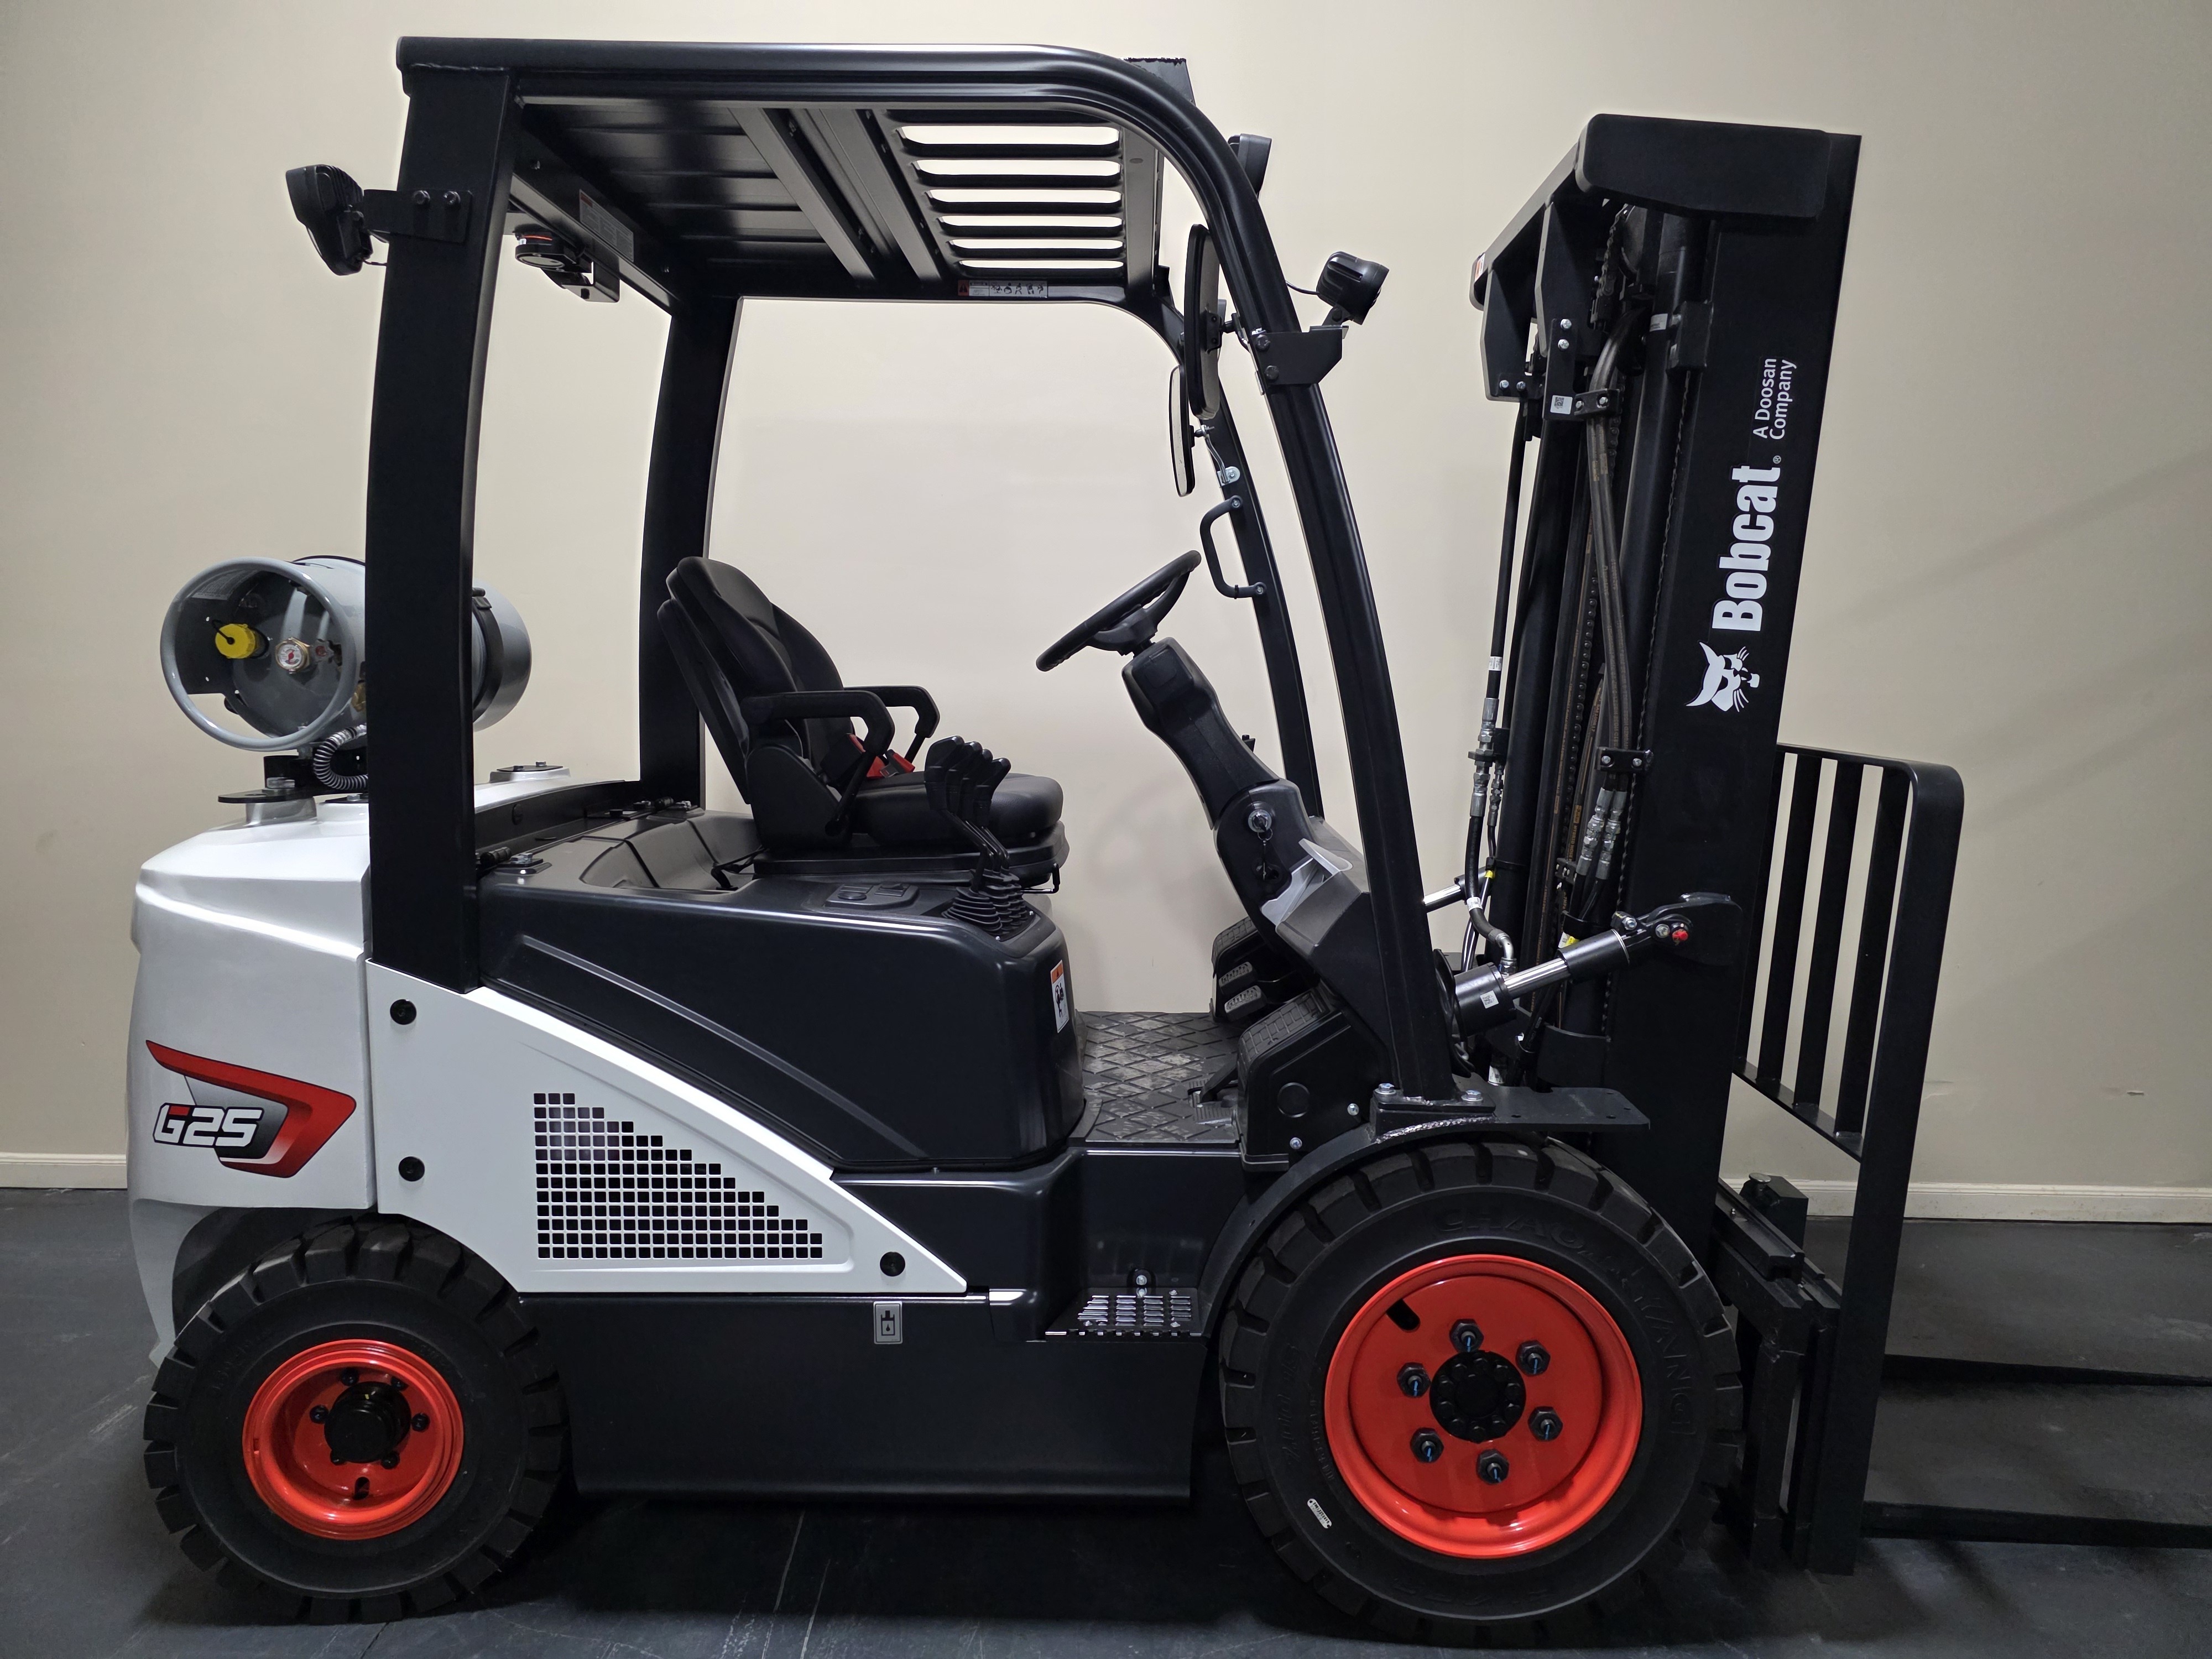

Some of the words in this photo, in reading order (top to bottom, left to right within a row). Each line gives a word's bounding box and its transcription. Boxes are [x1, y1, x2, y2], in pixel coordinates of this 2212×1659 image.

[1755, 358, 1777, 421] Doosan
[1770, 359, 1797, 440] Company
[1753, 426, 1769, 439] A
[1712, 466, 1781, 632] Bobcat
[154, 1104, 263, 1147] G25
